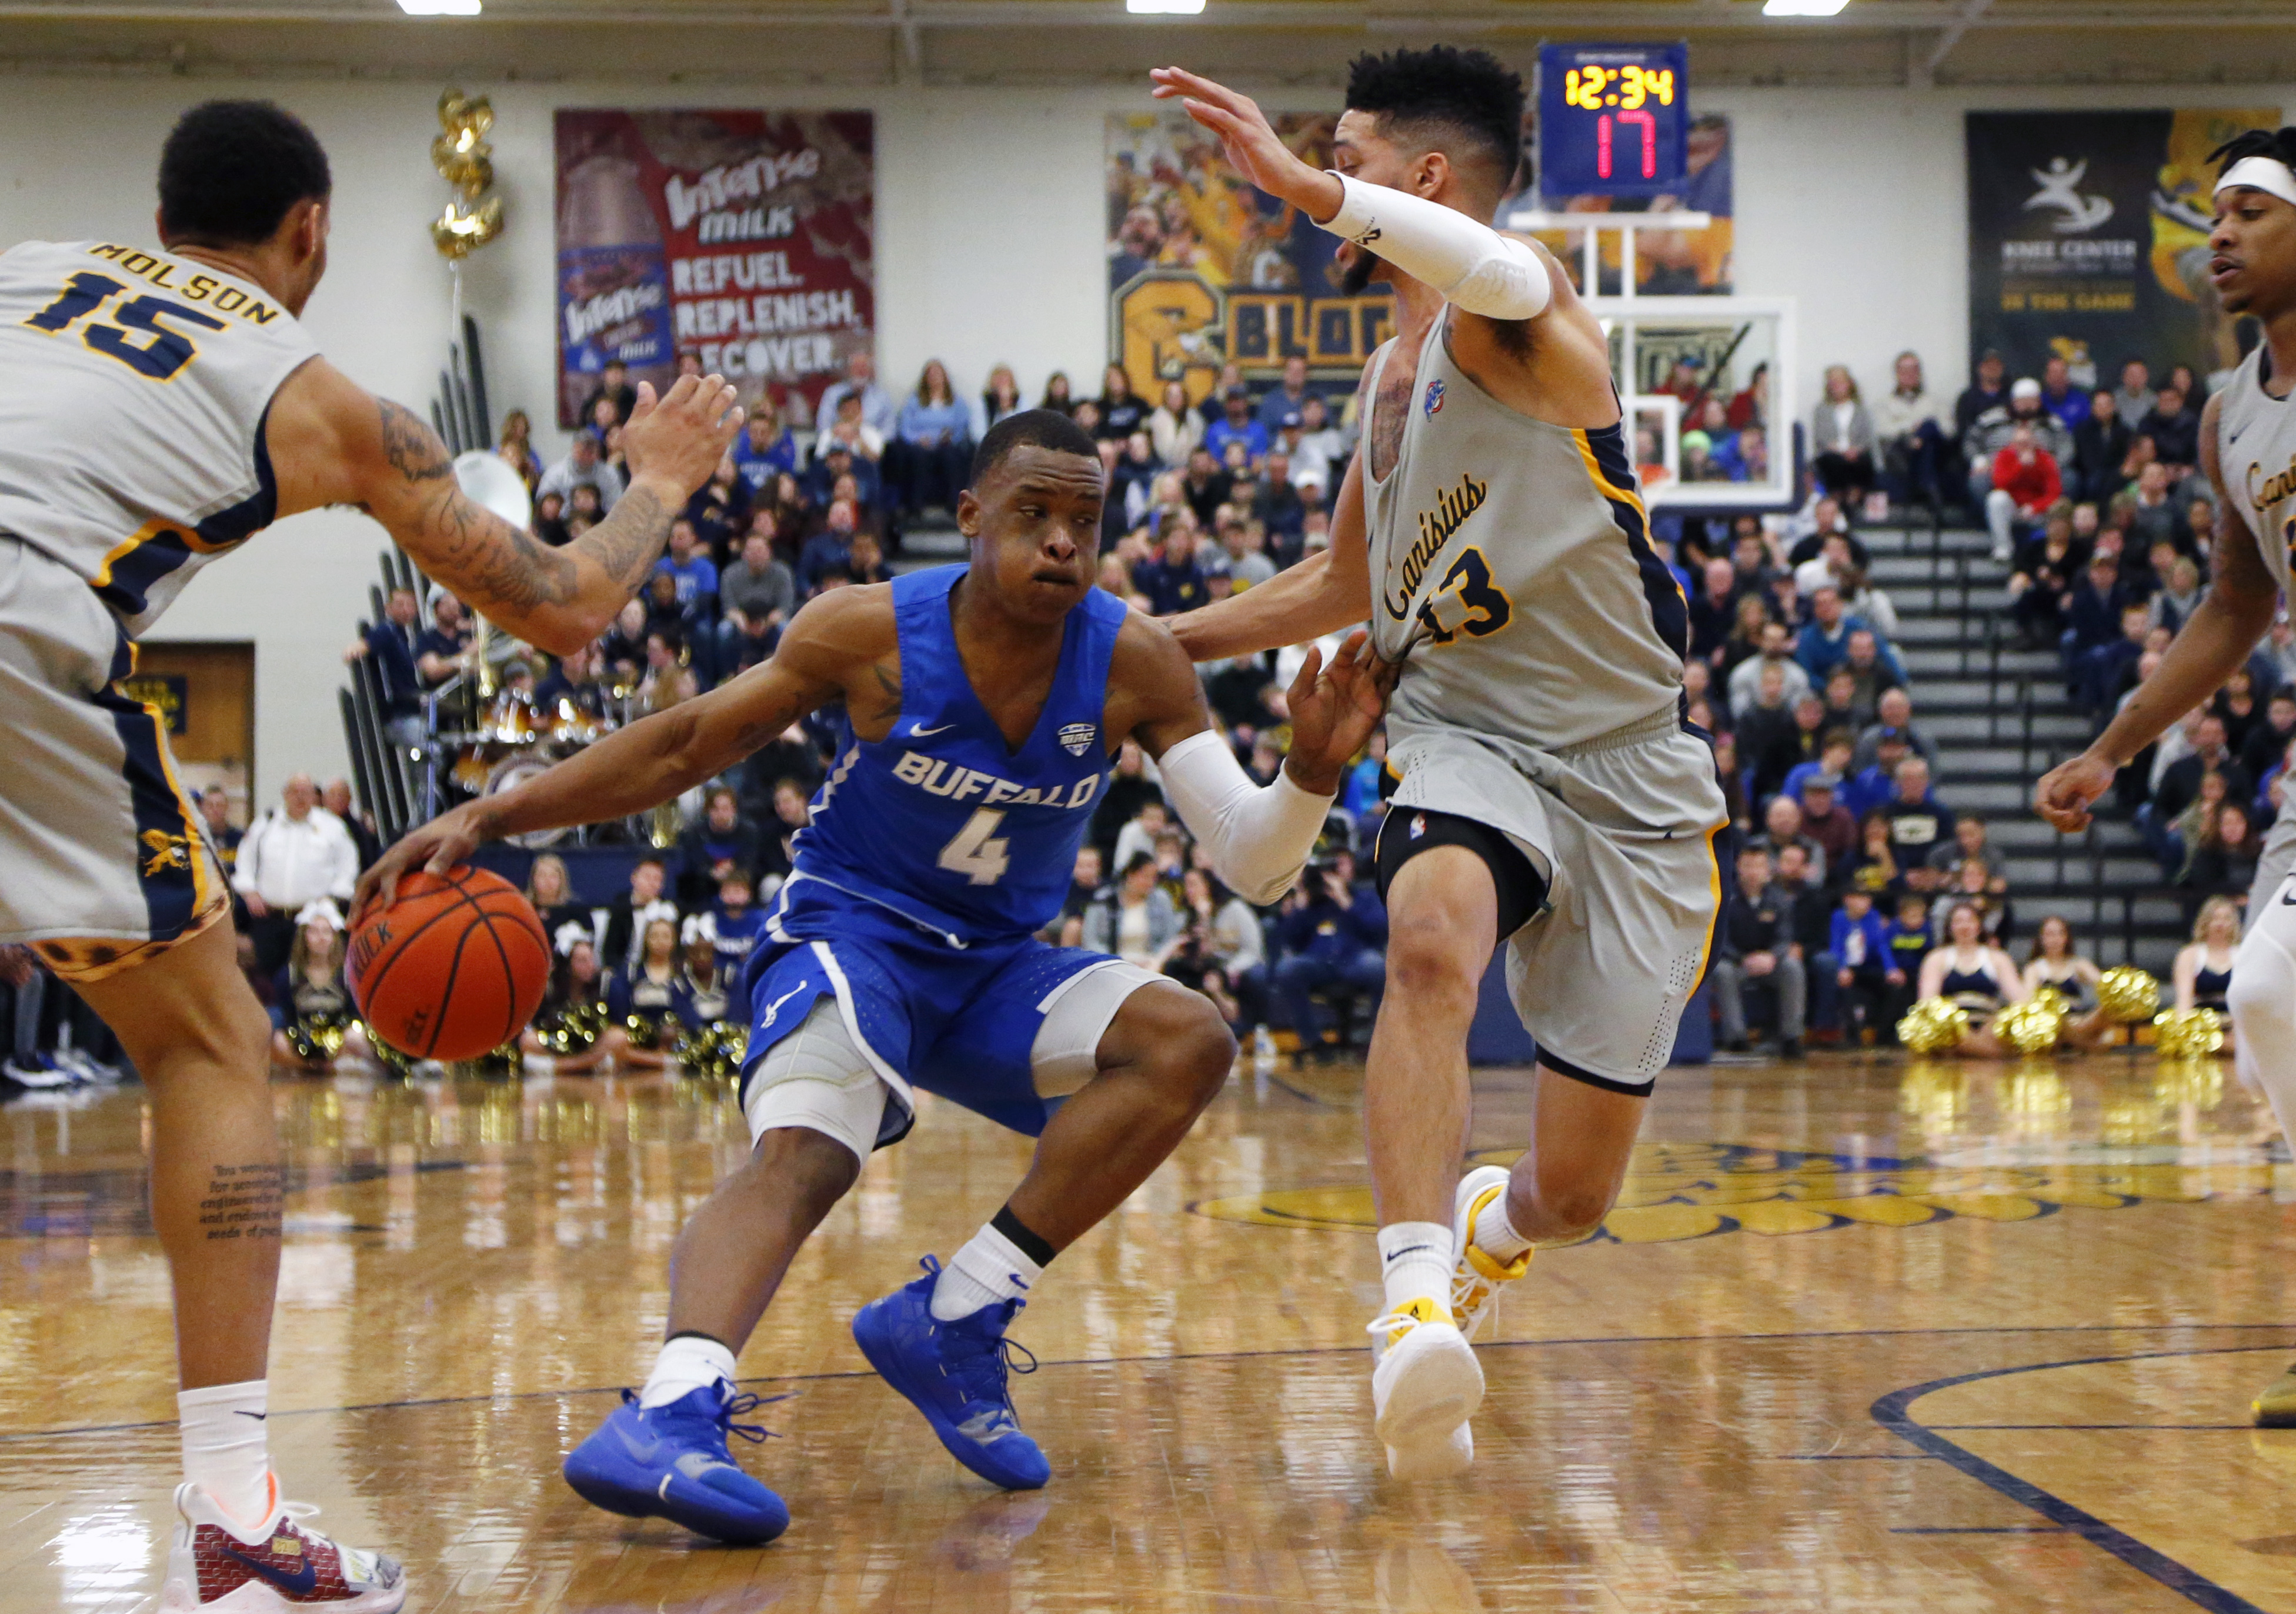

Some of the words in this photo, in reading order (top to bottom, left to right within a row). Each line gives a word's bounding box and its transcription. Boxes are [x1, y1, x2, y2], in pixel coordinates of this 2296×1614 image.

[1566, 65, 1673, 109] 12:34
[1597, 109, 1656, 178] 17
[665, 148, 820, 231] Intense
[89, 242, 281, 325] MOLSON
[672, 251, 804, 294] REFUEL.
[22, 270, 230, 383] 15
[679, 336, 842, 377] ECOVER.
[1384, 473, 1487, 622] Canisius
[892, 750, 1100, 809] BUFFALO
[937, 806, 1010, 885] 4
